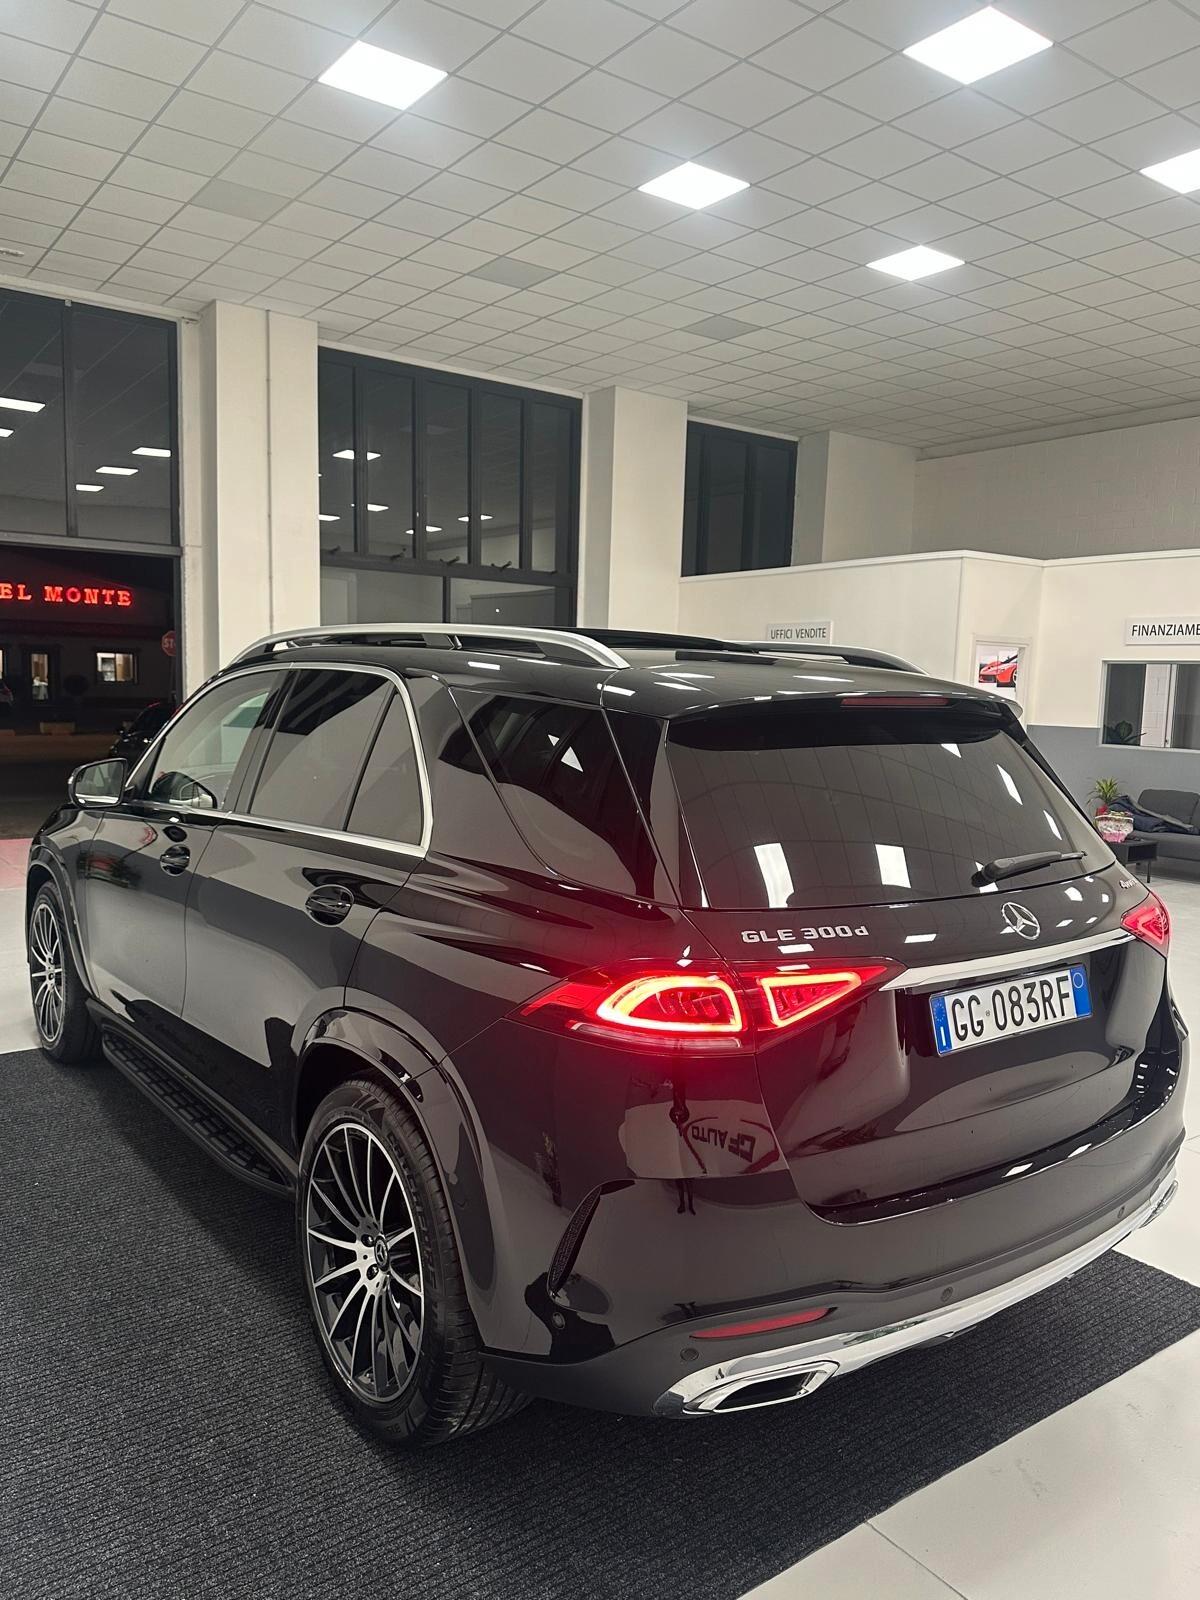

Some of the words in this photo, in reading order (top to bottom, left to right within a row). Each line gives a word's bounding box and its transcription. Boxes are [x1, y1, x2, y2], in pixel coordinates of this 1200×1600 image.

[44, 585, 132, 606] MONTE
[770, 629, 793, 640] UFFICI
[795, 627, 827, 639] VENDITE
[741, 929, 796, 943] GLE
[800, 925, 869, 940] 300d
[951, 998, 985, 1042] GG
[991, 975, 1070, 1031] 083RF
[692, 1126, 728, 1149] AUTO
